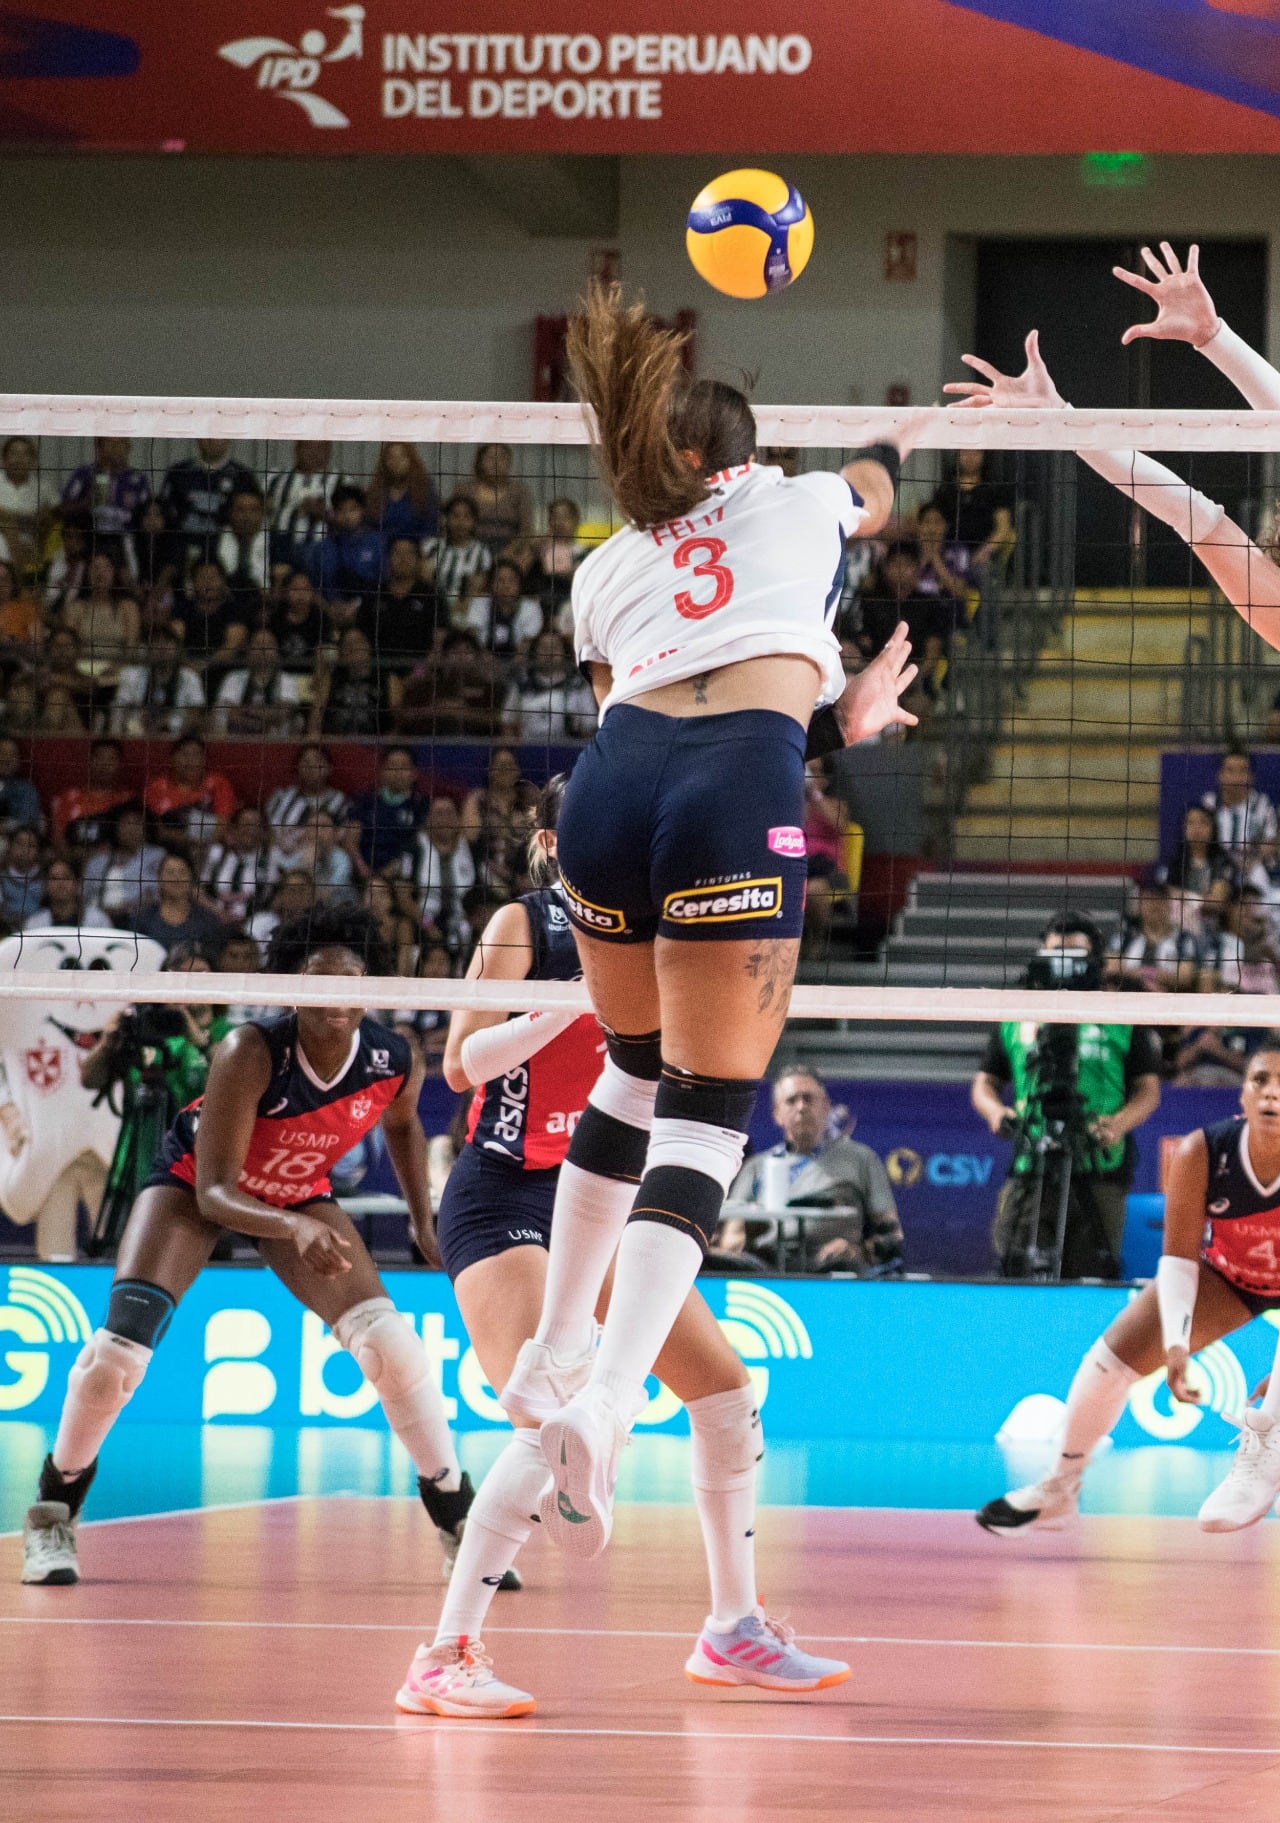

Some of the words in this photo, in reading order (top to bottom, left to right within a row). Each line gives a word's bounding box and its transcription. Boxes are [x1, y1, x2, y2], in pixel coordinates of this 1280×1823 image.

[382, 34, 596, 74] INSTITUTO
[606, 34, 813, 74] PERUANO
[257, 57, 320, 90] IPD
[382, 79, 463, 118] DEL
[471, 79, 663, 119] DEPORTE
[673, 536, 735, 620] 3
[695, 871, 752, 887] PINTURAS
[668, 888, 775, 918] Ceresita
[279, 1129, 340, 1149] USMP
[262, 1148, 326, 1179] 18
[927, 1152, 993, 1186] CSV
[1247, 1240, 1278, 1270] 4
